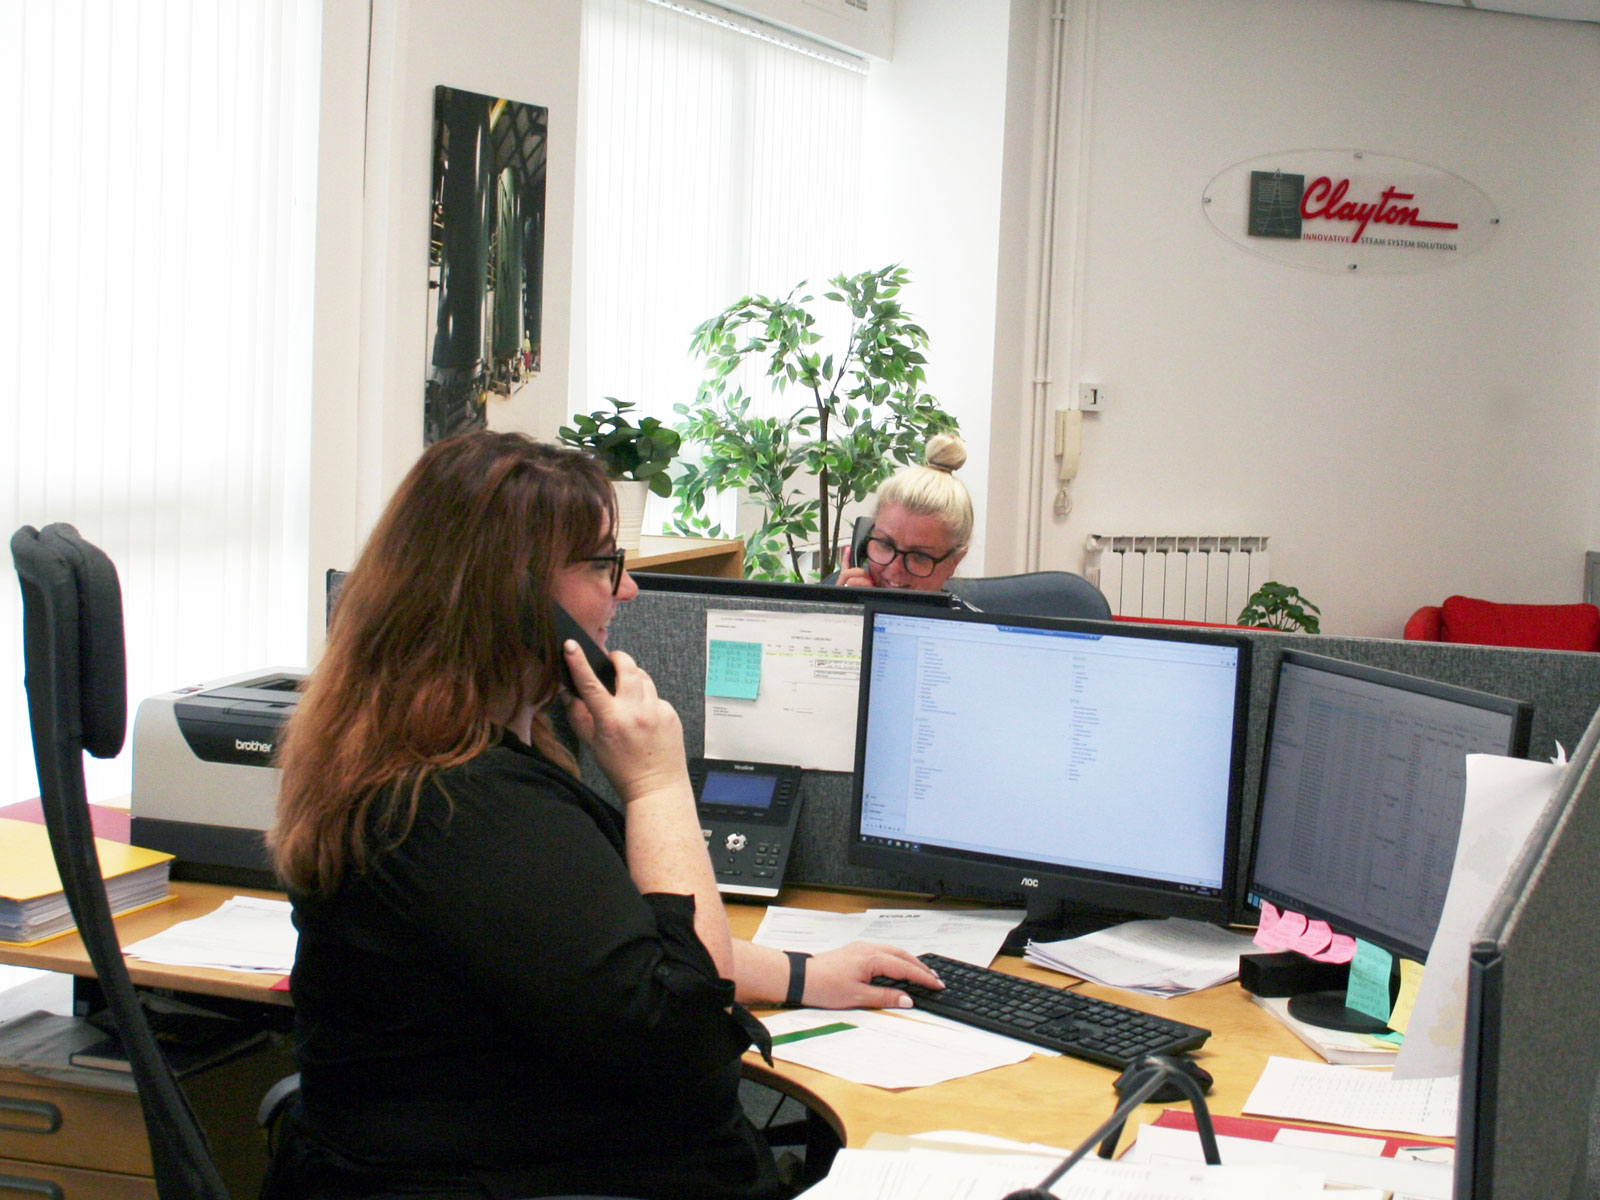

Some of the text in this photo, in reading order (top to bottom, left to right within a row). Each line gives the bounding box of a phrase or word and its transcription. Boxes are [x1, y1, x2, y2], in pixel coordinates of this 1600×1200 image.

[1300, 176, 1458, 243] Clayton
[1302, 232, 1458, 251] INNOVATIVE STEAM SYSTEM SOLUTIONS
[235, 739, 273, 753] brother
